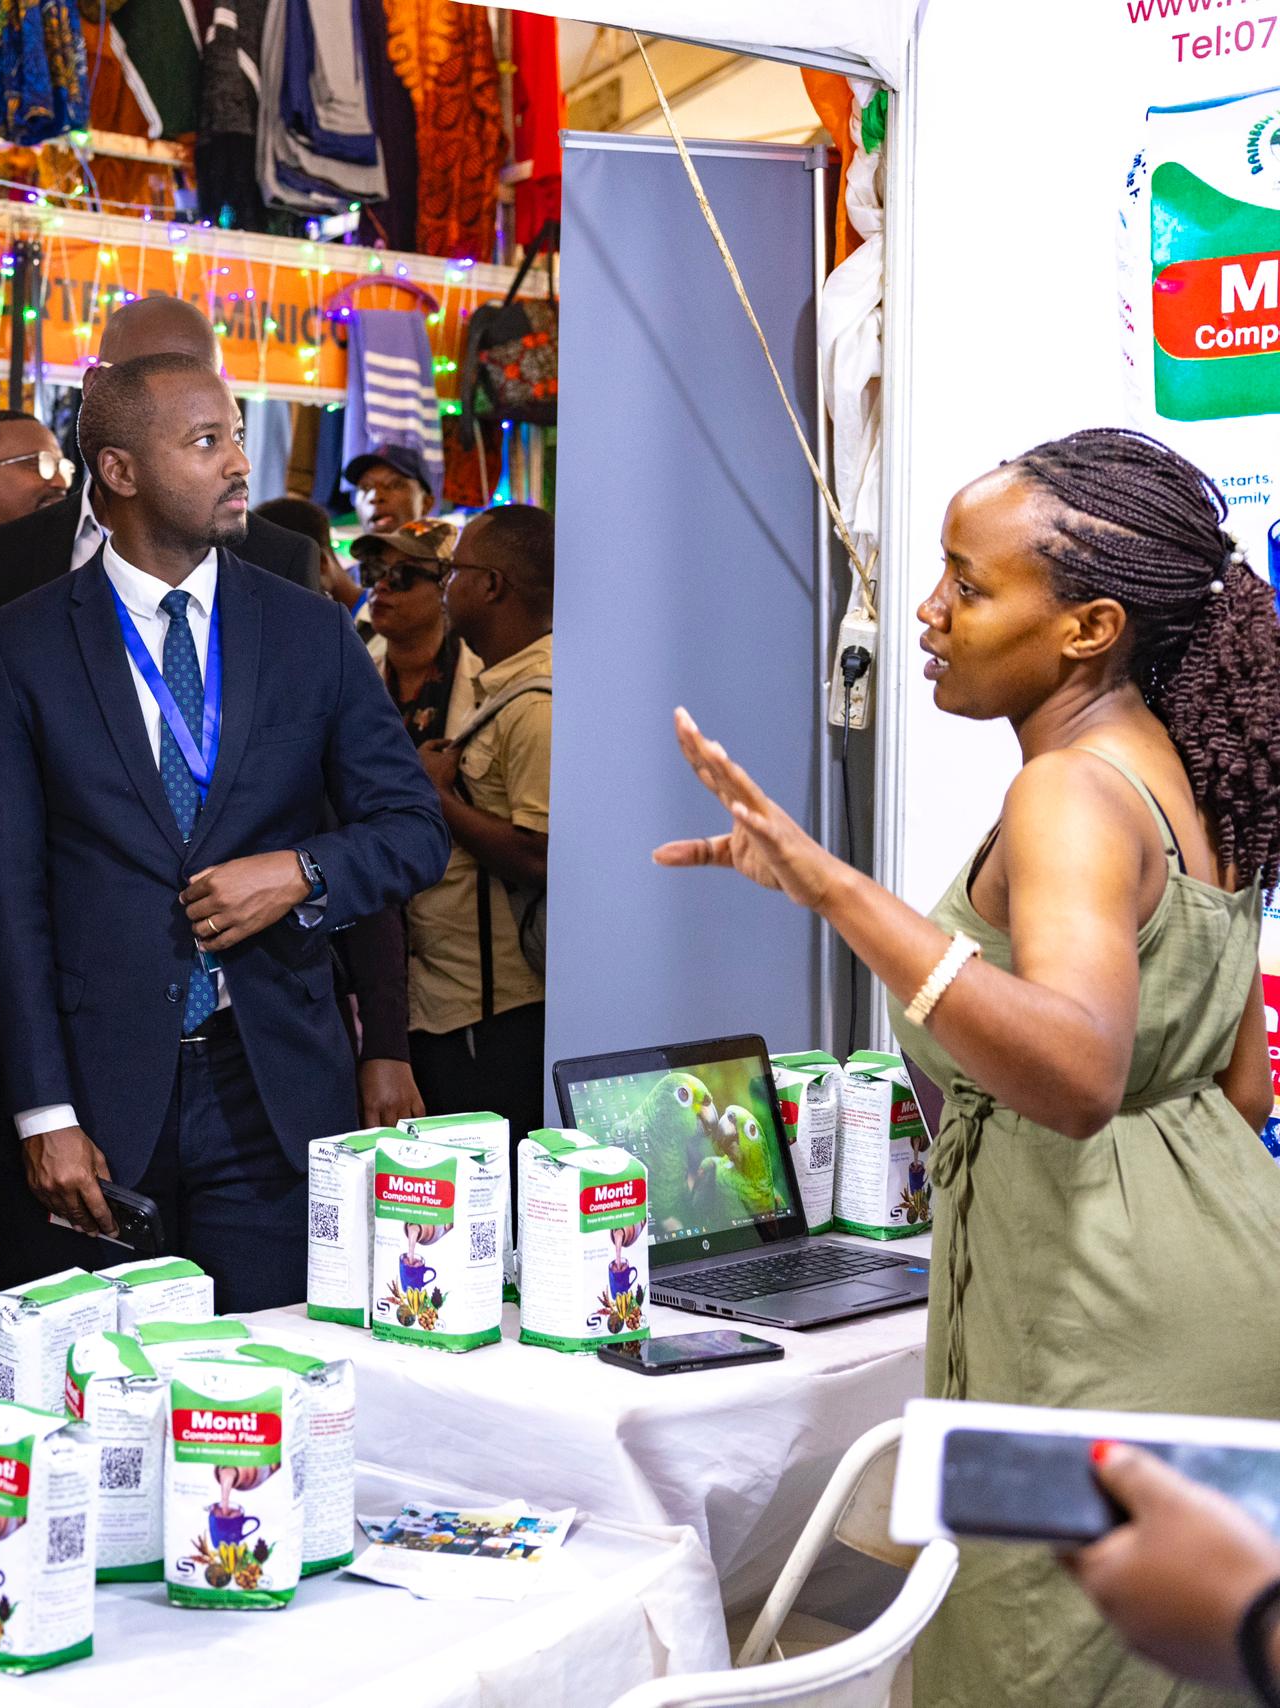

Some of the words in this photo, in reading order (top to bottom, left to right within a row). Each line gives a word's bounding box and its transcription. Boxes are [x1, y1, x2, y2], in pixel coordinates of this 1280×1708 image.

[1172, 16, 1277, 62] Tel:07
[1222, 474, 1273, 488] starts.
[388, 1176, 437, 1195] Monti
[595, 1181, 633, 1202] Monti
[382, 1191, 422, 1204] Composite
[422, 1196, 442, 1205] Flour
[589, 1200, 621, 1212] Composite
[621, 1197, 638, 1206] Flour
[191, 1411, 258, 1431] Monti
[182, 1429, 237, 1443] Composite
[238, 1432, 266, 1443] Flour
